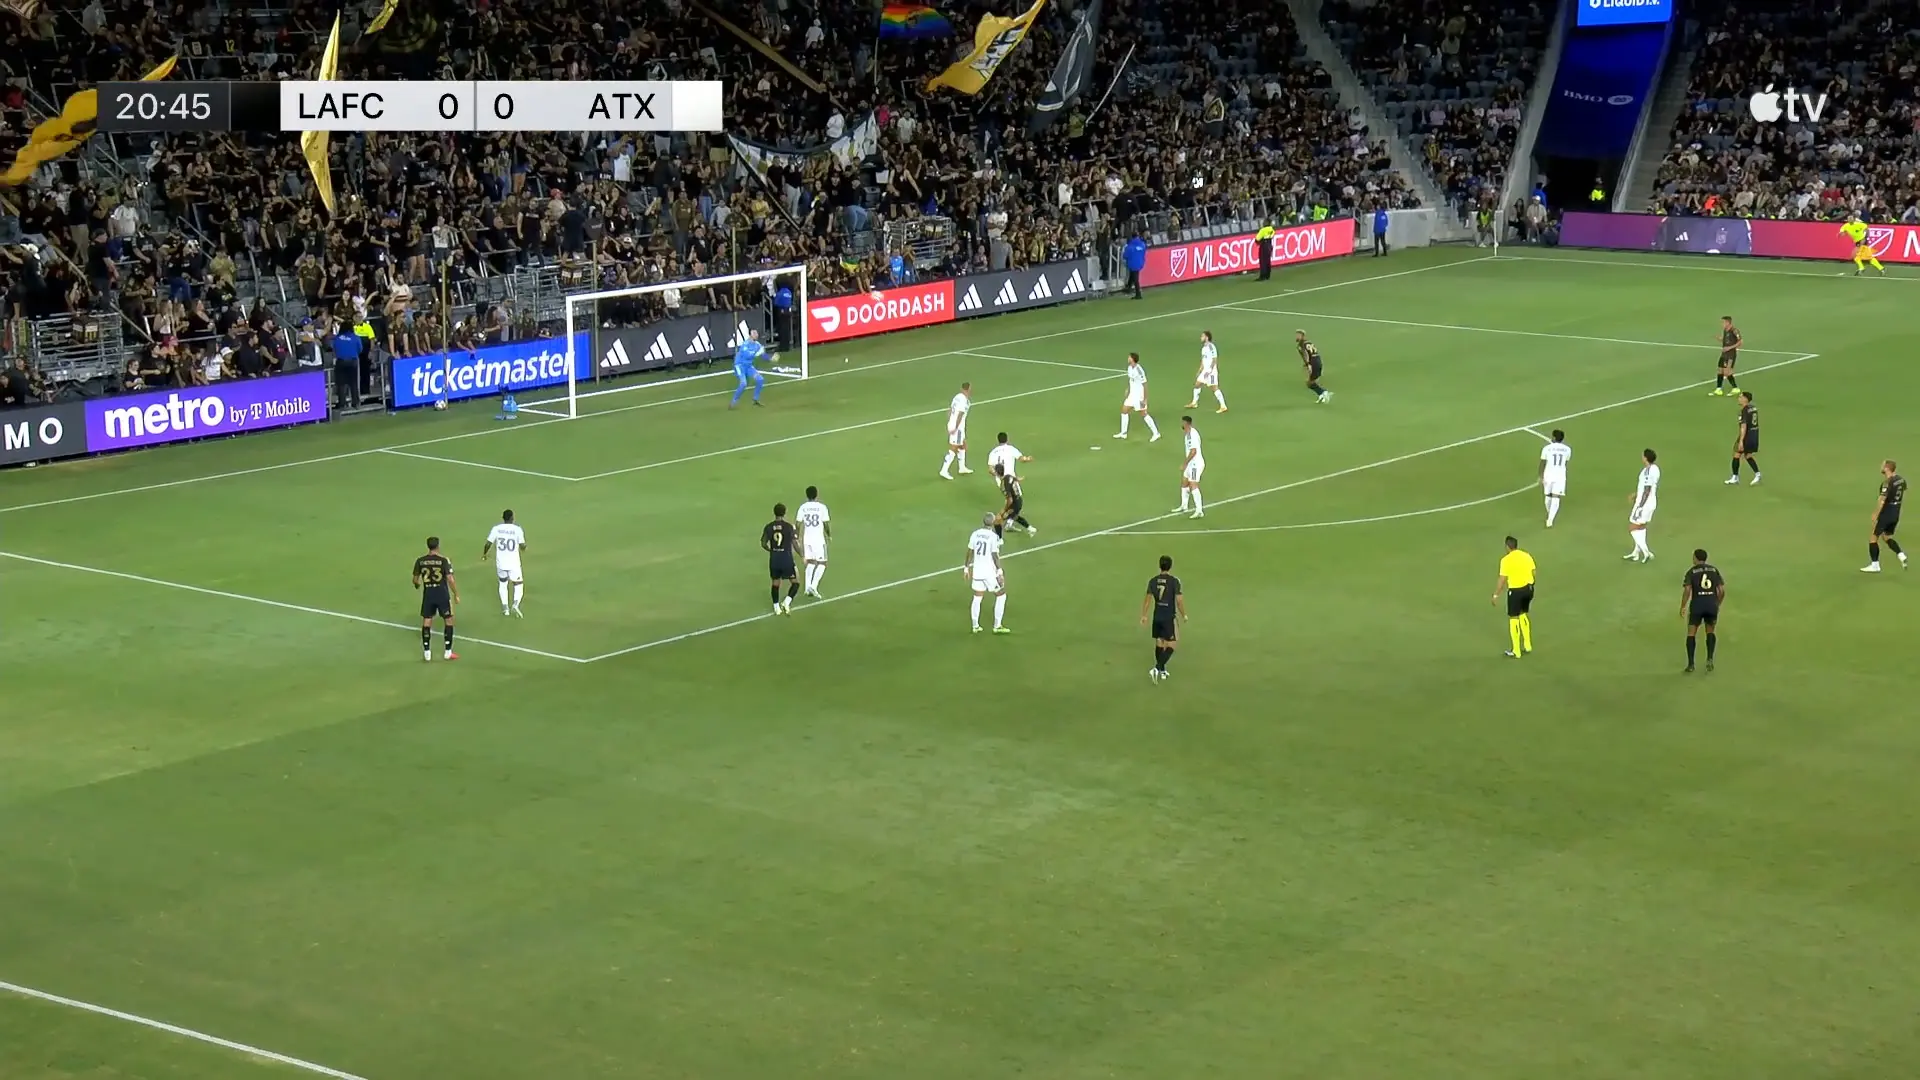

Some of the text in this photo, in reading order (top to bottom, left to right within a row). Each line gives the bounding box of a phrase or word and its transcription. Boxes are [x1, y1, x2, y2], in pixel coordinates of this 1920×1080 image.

[1193, 227, 1326, 275] MLSSTOE.COM
[847, 292, 945, 326] DOORDASH
[104, 393, 225, 438] metro
[229, 406, 248, 426] by
[265, 397, 311, 418] Mobile
[1552, 453, 1563, 466] 11
[804, 513, 820, 527] 38
[498, 537, 515, 552] 30
[773, 532, 783, 546] 9
[976, 540, 987, 556] 21
[421, 567, 443, 583] 23
[1701, 573, 1712, 589] 6
[1157, 585, 1166, 600] 7
